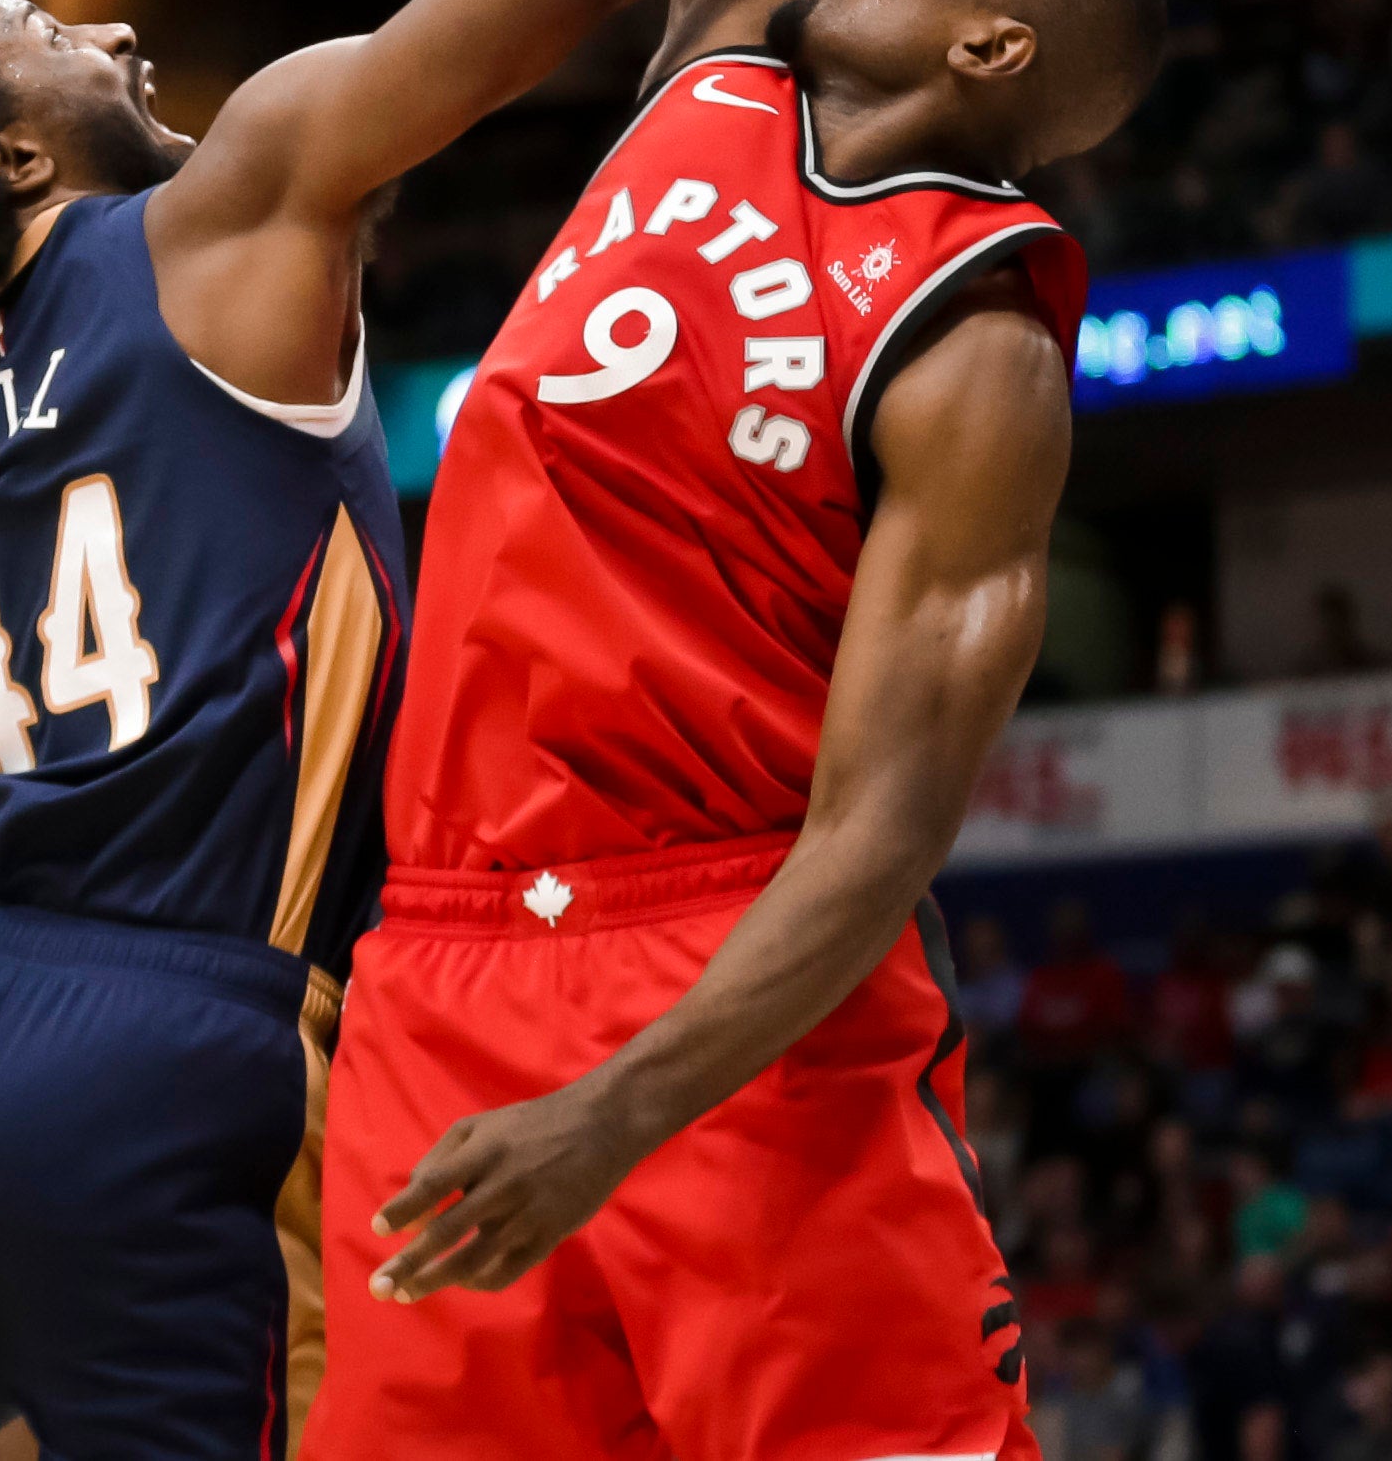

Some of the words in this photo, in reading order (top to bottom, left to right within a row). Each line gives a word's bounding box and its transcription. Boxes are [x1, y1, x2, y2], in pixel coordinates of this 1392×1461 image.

[537, 286, 678, 405] 9
[538, 178, 824, 473] RAPTORS
[827, 260, 852, 293] Sun
[848, 285, 873, 317] Life
